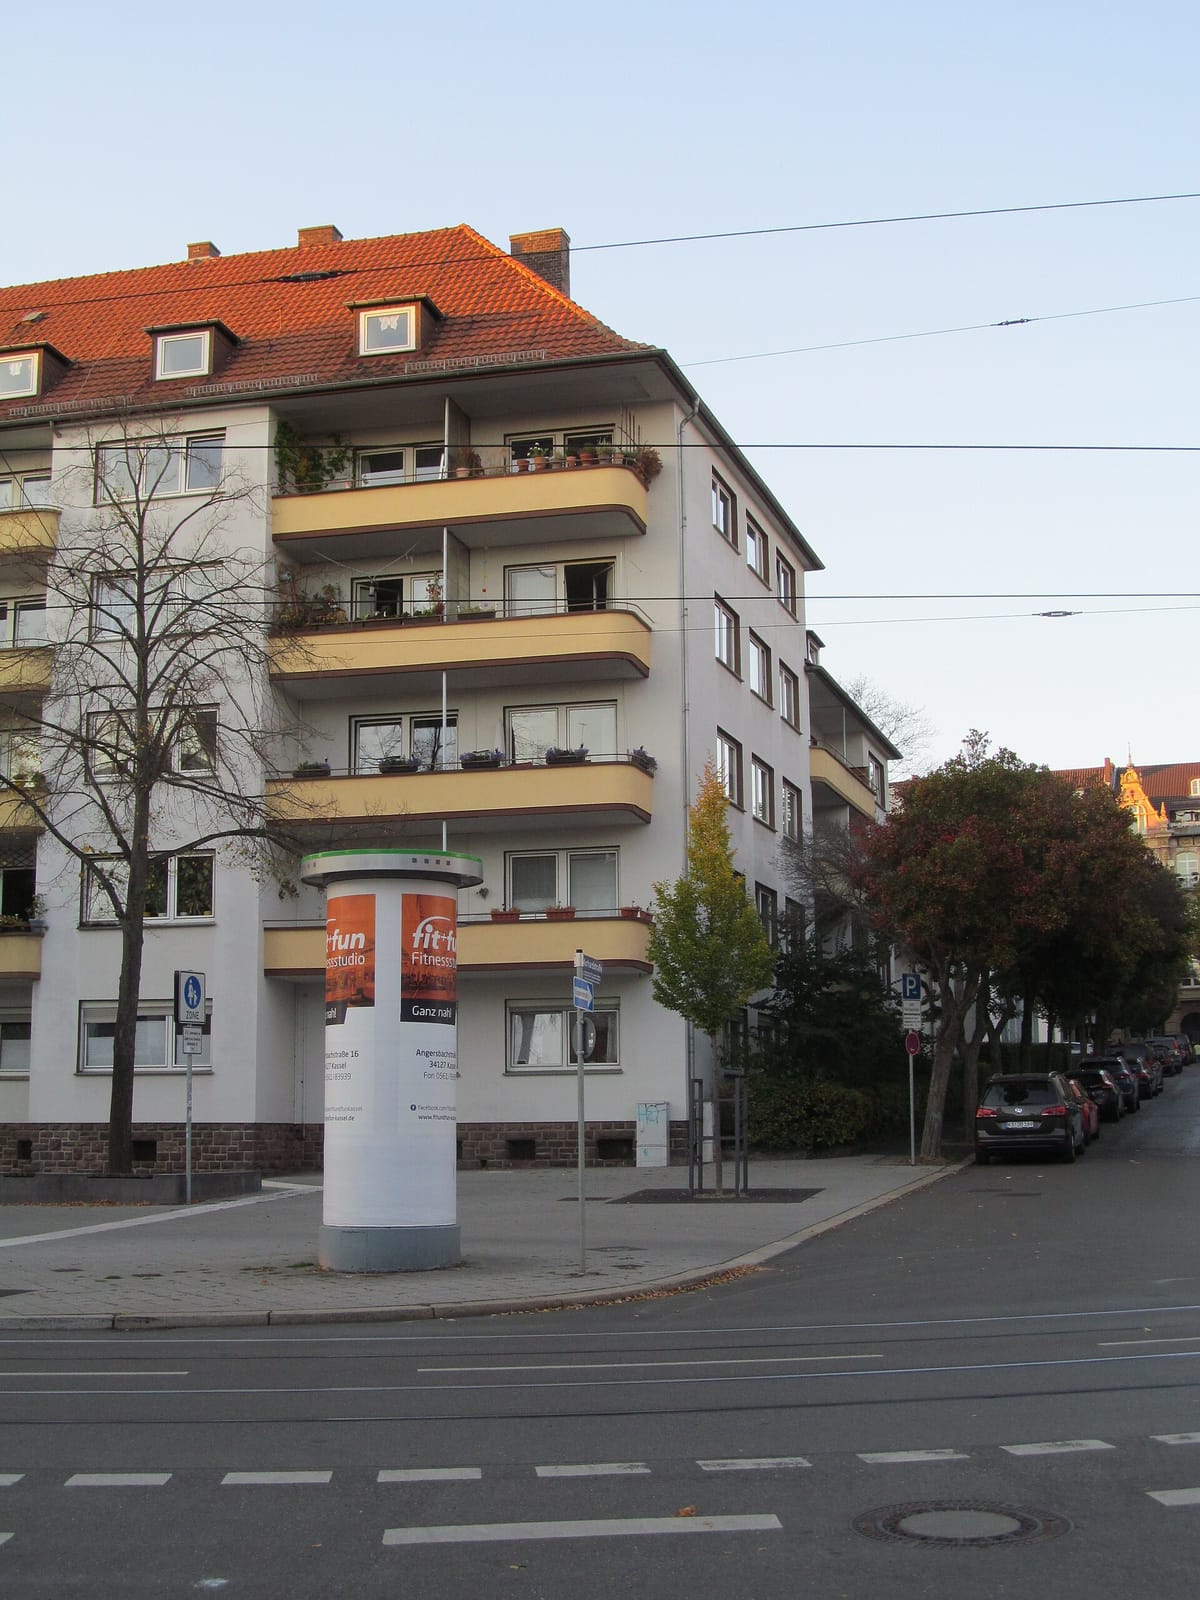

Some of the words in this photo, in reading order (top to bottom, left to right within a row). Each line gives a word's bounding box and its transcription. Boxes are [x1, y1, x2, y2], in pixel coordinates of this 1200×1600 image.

[906, 976, 917, 997] P
[186, 1010, 200, 1020] ZONE
[412, 1005, 437, 1017] Ganz
[437, 1007, 452, 1018] nah!
[350, 1050, 360, 1058] 16
[429, 1061, 447, 1069] 34127
